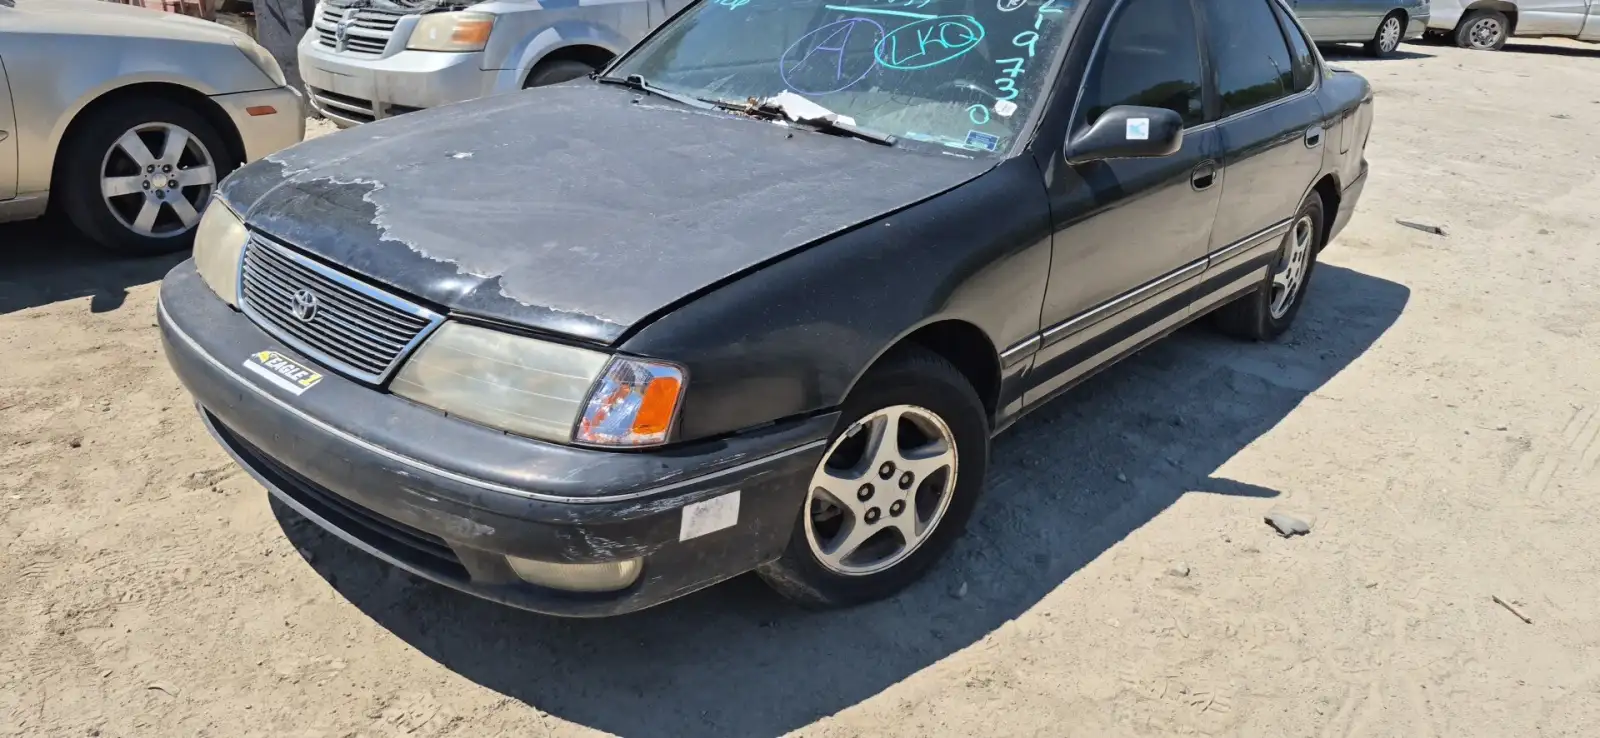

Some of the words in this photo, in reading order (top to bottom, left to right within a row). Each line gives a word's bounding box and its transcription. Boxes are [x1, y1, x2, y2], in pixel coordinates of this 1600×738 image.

[788, 21, 854, 80] A
[891, 22, 978, 65] LKQ
[266, 356, 309, 381] EAGLE
